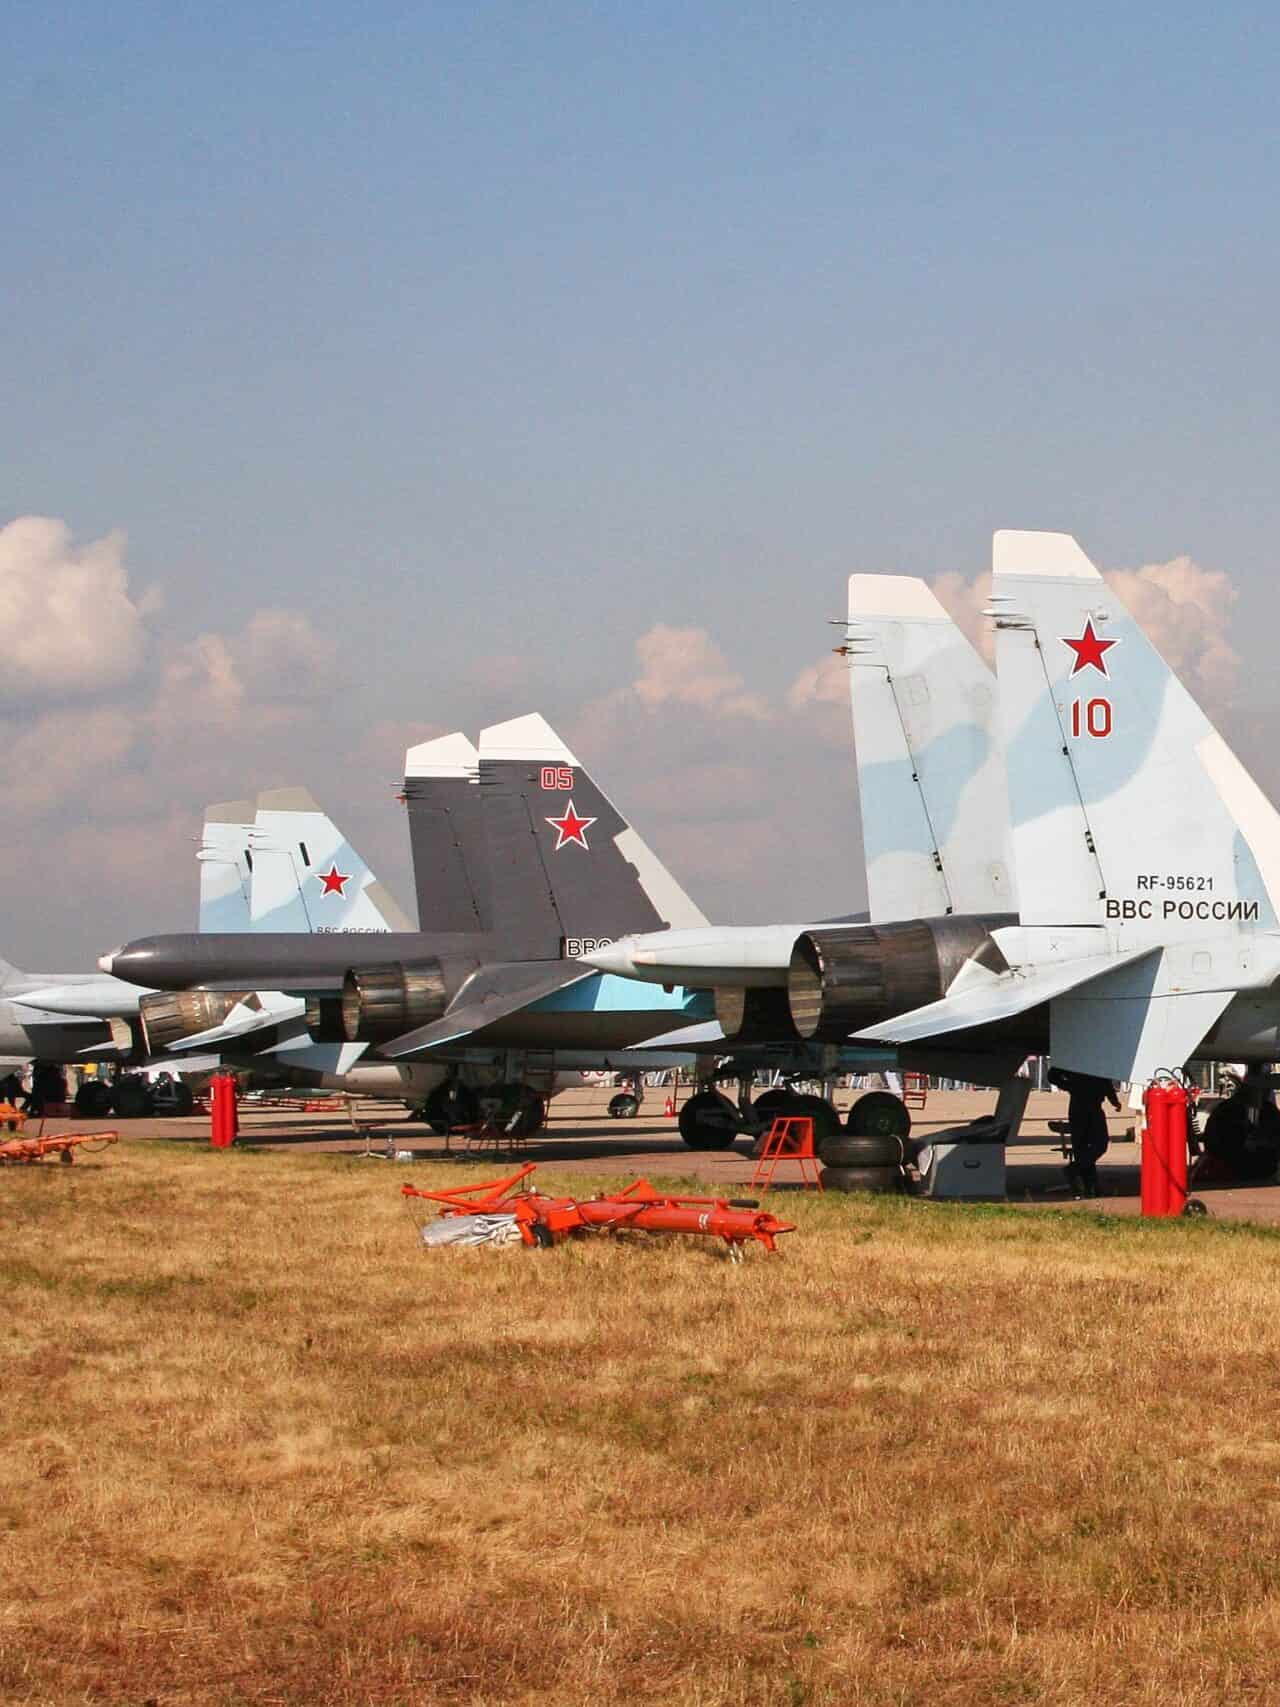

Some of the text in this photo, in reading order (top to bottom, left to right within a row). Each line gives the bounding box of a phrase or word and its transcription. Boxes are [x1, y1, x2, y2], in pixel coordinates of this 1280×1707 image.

[1072, 697, 1112, 738] 10
[541, 767, 574, 790] 05
[1137, 875, 1214, 891] RF-95621
[1106, 899, 1260, 921] ВВС РОССИИ
